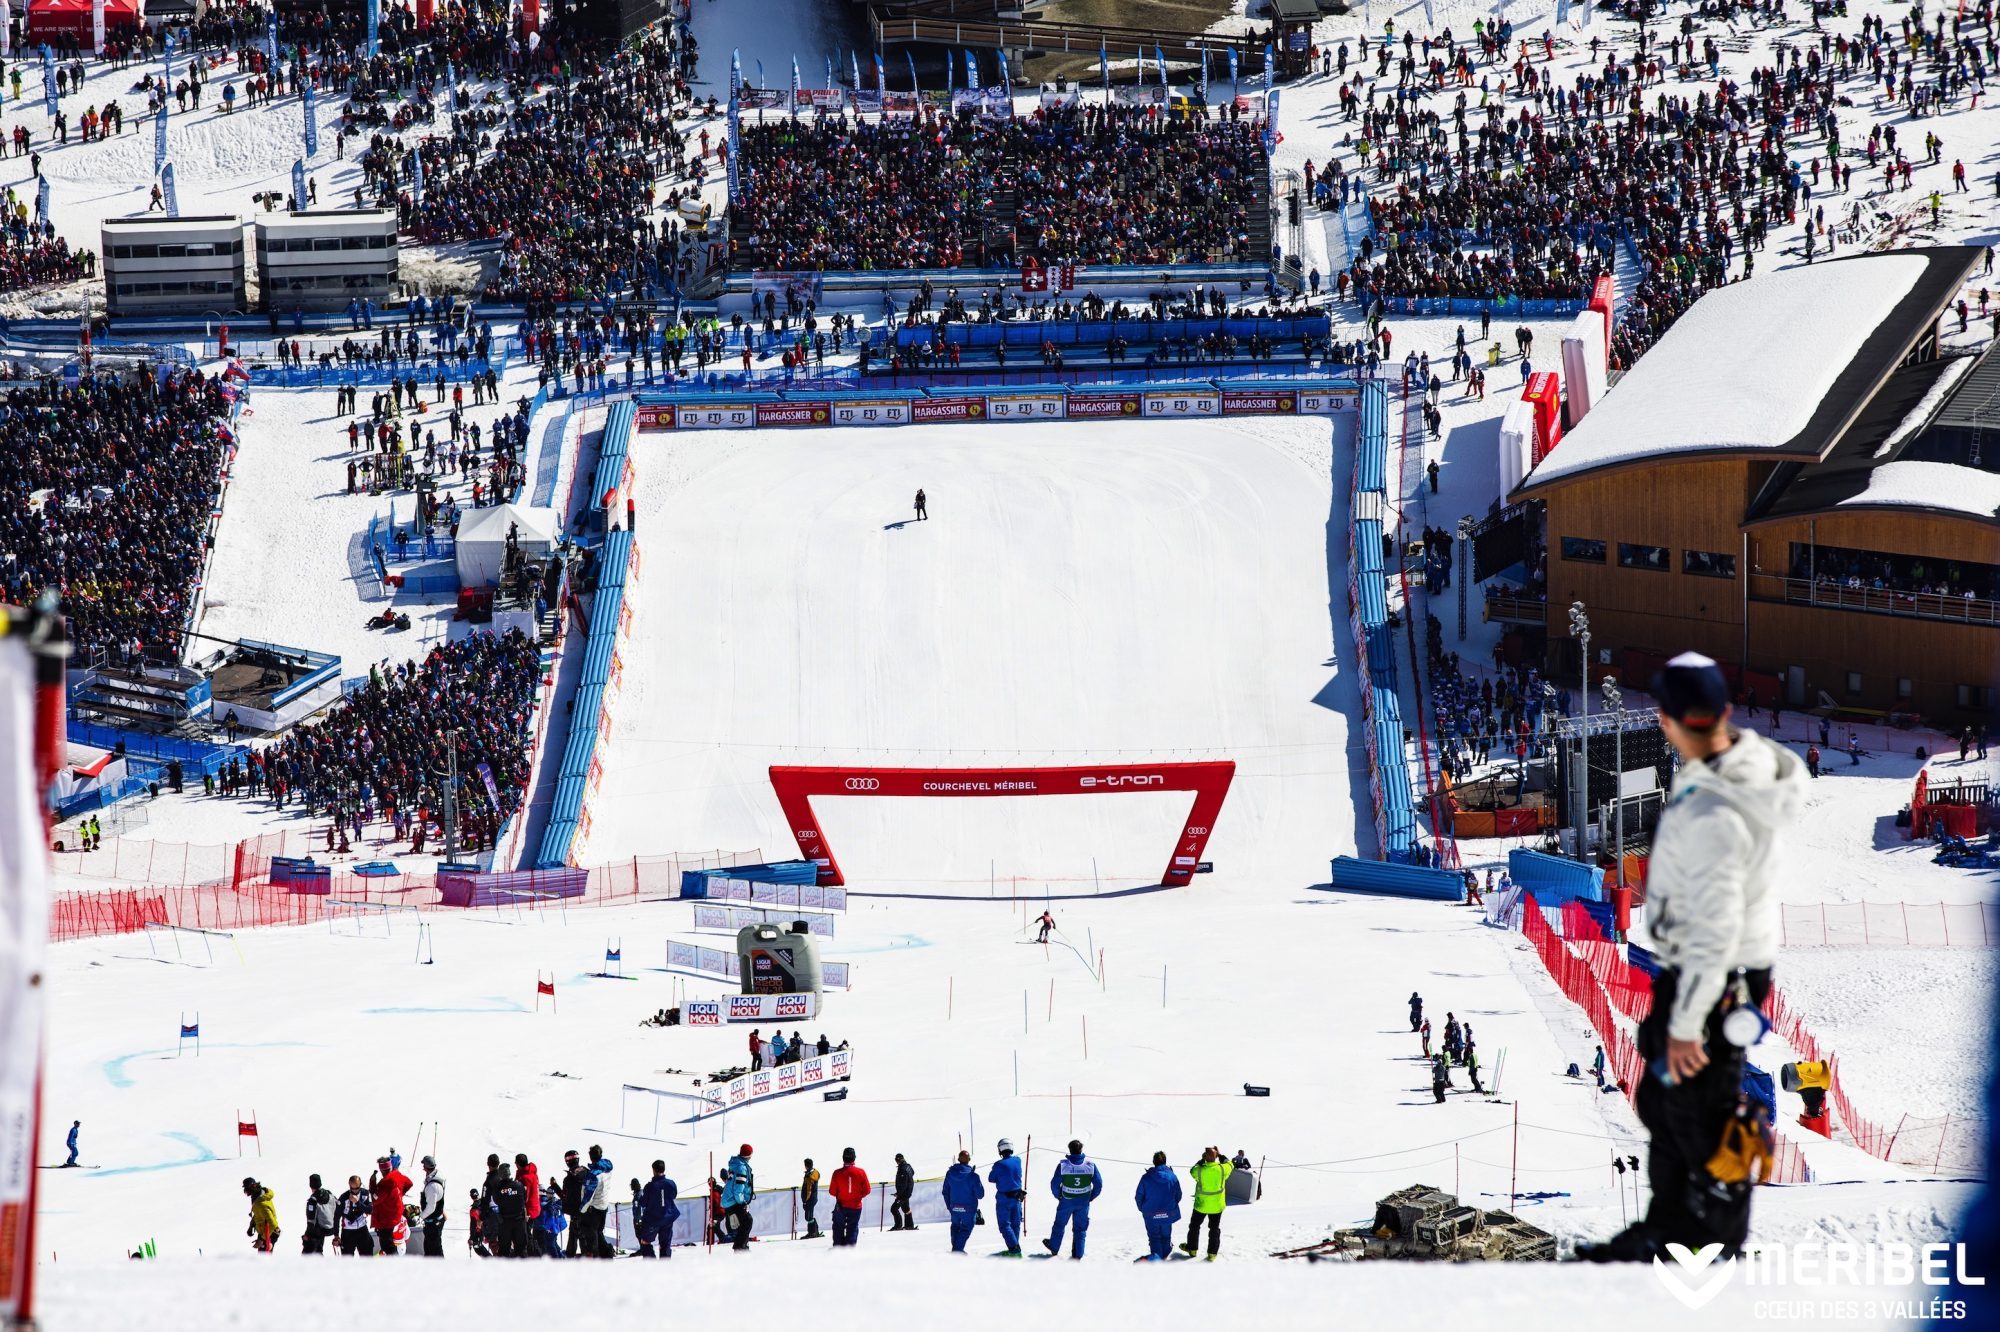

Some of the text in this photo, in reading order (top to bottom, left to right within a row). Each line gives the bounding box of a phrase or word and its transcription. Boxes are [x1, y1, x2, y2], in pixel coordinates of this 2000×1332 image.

[994, 402, 1056, 413] FTI FTI FTI
[1069, 402, 1122, 412] HARGASSNER
[1150, 400, 1211, 409] FTI FTI FTI
[1224, 399, 1277, 409] HARGASSNER
[684, 412, 745, 421] FTI FTI FTI
[759, 410, 811, 421] HARGASSNER
[840, 408, 901, 418] FTI FTI FTI
[914, 405, 967, 417] HARGASSNER
[923, 780, 1037, 791] COURCHEVEL MÉRIBEL
[1079, 775, 1164, 787] e-tron
[732, 998, 760, 1007] LIQUI
[778, 996, 806, 1005] LIQUI
[690, 1005, 718, 1014] LIQUI
[731, 1007, 760, 1016] MOLY
[777, 1005, 806, 1015] MOLY
[689, 1014, 719, 1024] MOLY
[832, 1053, 848, 1064] LIQUI
[803, 1059, 821, 1070] LIQUI
[779, 1066, 796, 1077] LIQUI
[803, 1070, 823, 1082] MOLY
[832, 1064, 848, 1077] MOLY
[753, 1072, 770, 1084] LIQUI
[779, 1077, 797, 1089] MOLY
[731, 1079, 745, 1092] LIQUI
[753, 1083, 770, 1096] MOLY
[731, 1091, 746, 1104] MOLY
[1074, 1177, 1081, 1187] 3
